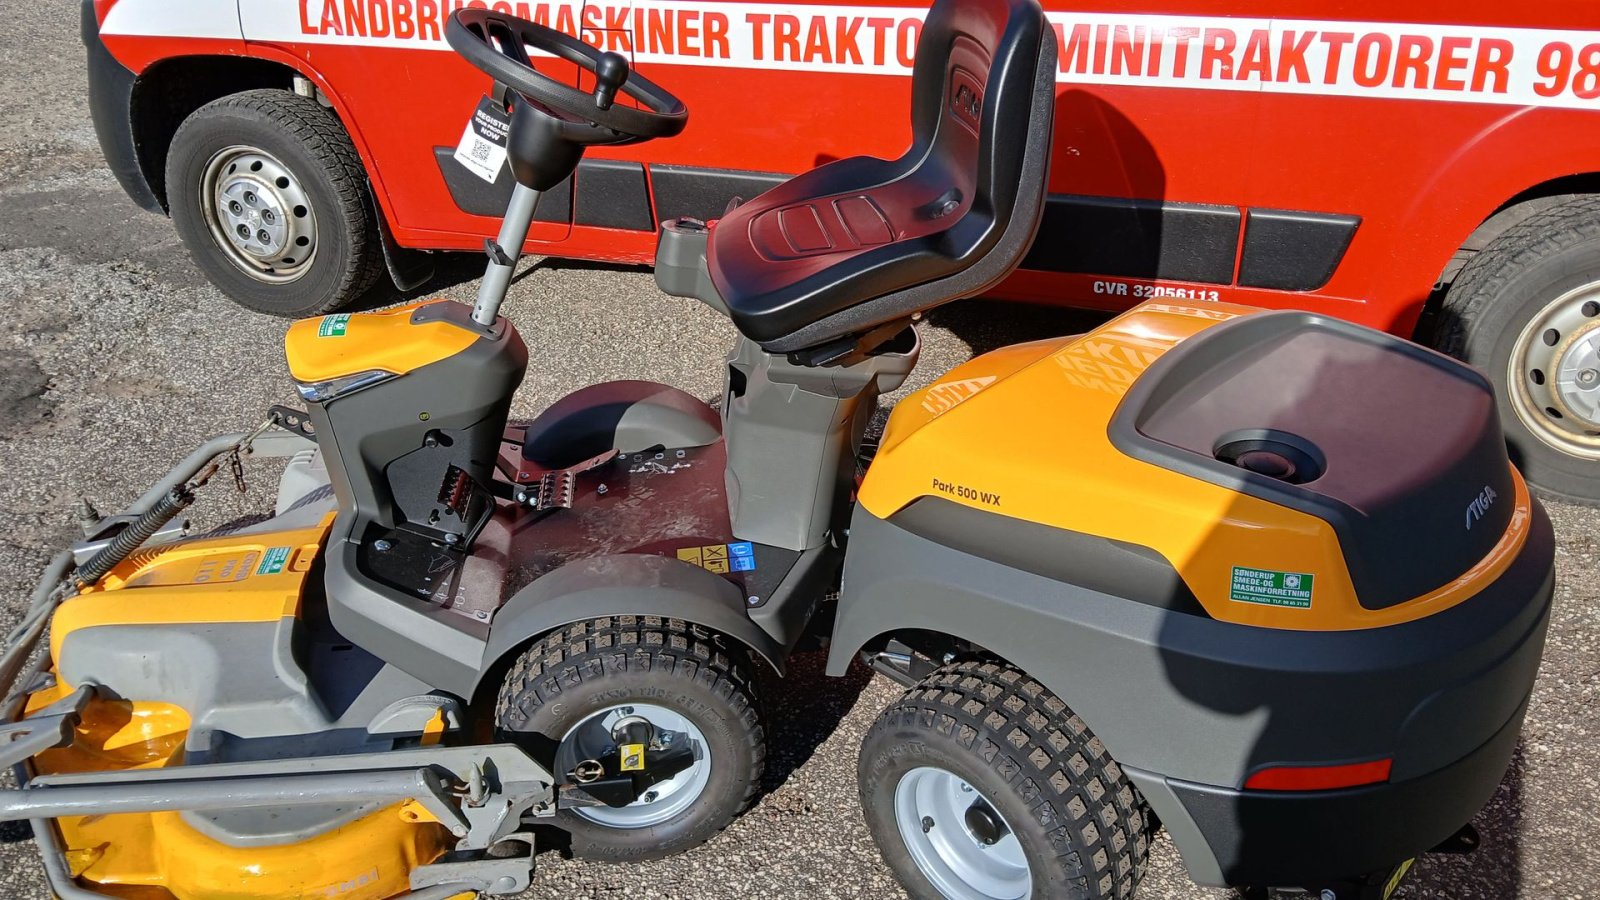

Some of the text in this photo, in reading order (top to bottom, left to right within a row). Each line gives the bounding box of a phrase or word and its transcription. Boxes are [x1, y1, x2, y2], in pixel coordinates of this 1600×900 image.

[300, 0, 730, 58] LANDBRASKINER
[1052, 23, 1514, 94] MINITRAKTORER
[1533, 41, 1600, 99] 98
[481, 126, 500, 141] NOW
[1093, 281, 1219, 302] CVR 32056113
[932, 478, 1001, 507] Park 500 WX
[1234, 568, 1275, 580] SØNDERUP
[1233, 576, 1274, 588] SMEDE-OG
[1232, 583, 1310, 598] MASKINFORRETNING
